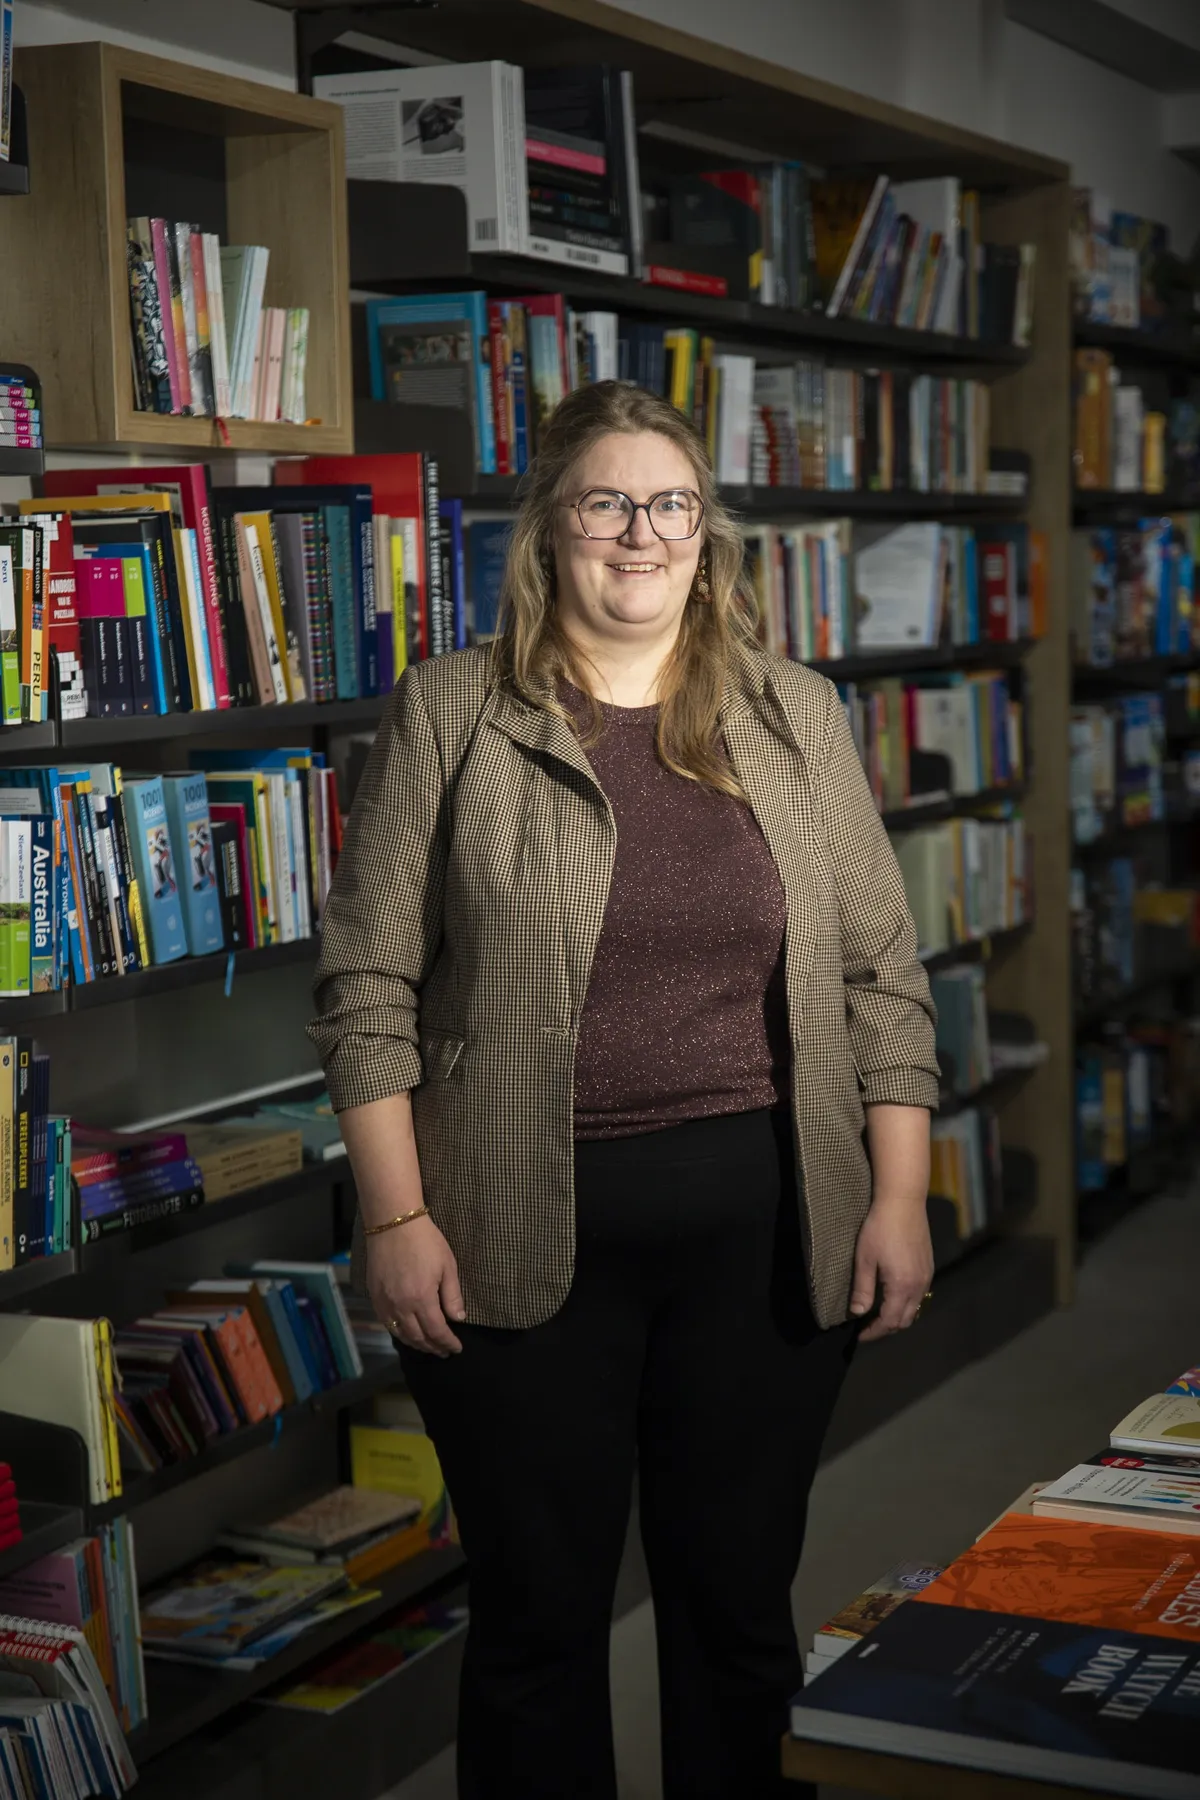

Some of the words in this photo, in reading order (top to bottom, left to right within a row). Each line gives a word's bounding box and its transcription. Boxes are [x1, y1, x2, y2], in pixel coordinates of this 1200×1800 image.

[428, 462, 439, 484] THE
[201, 506, 215, 561] MODERN
[428, 486, 440, 537] ROLLING
[207, 563, 219, 607] LIVING
[430, 538, 442, 587] STONES
[136, 621, 144, 661] Nederlands
[33, 651, 41, 698] PERU
[141, 788, 161, 810] 1001
[184, 783, 204, 802] 1001
[33, 844, 51, 948] Australia
[61, 877, 69, 920] SYDNEY
[19, 1111, 29, 1188] WERELDPLEKKEN
[123, 1196, 181, 1229] FOTOGRAFIE
[1061, 1644, 1140, 1699] BOOK
[1098, 1654, 1189, 1720] WATCH
